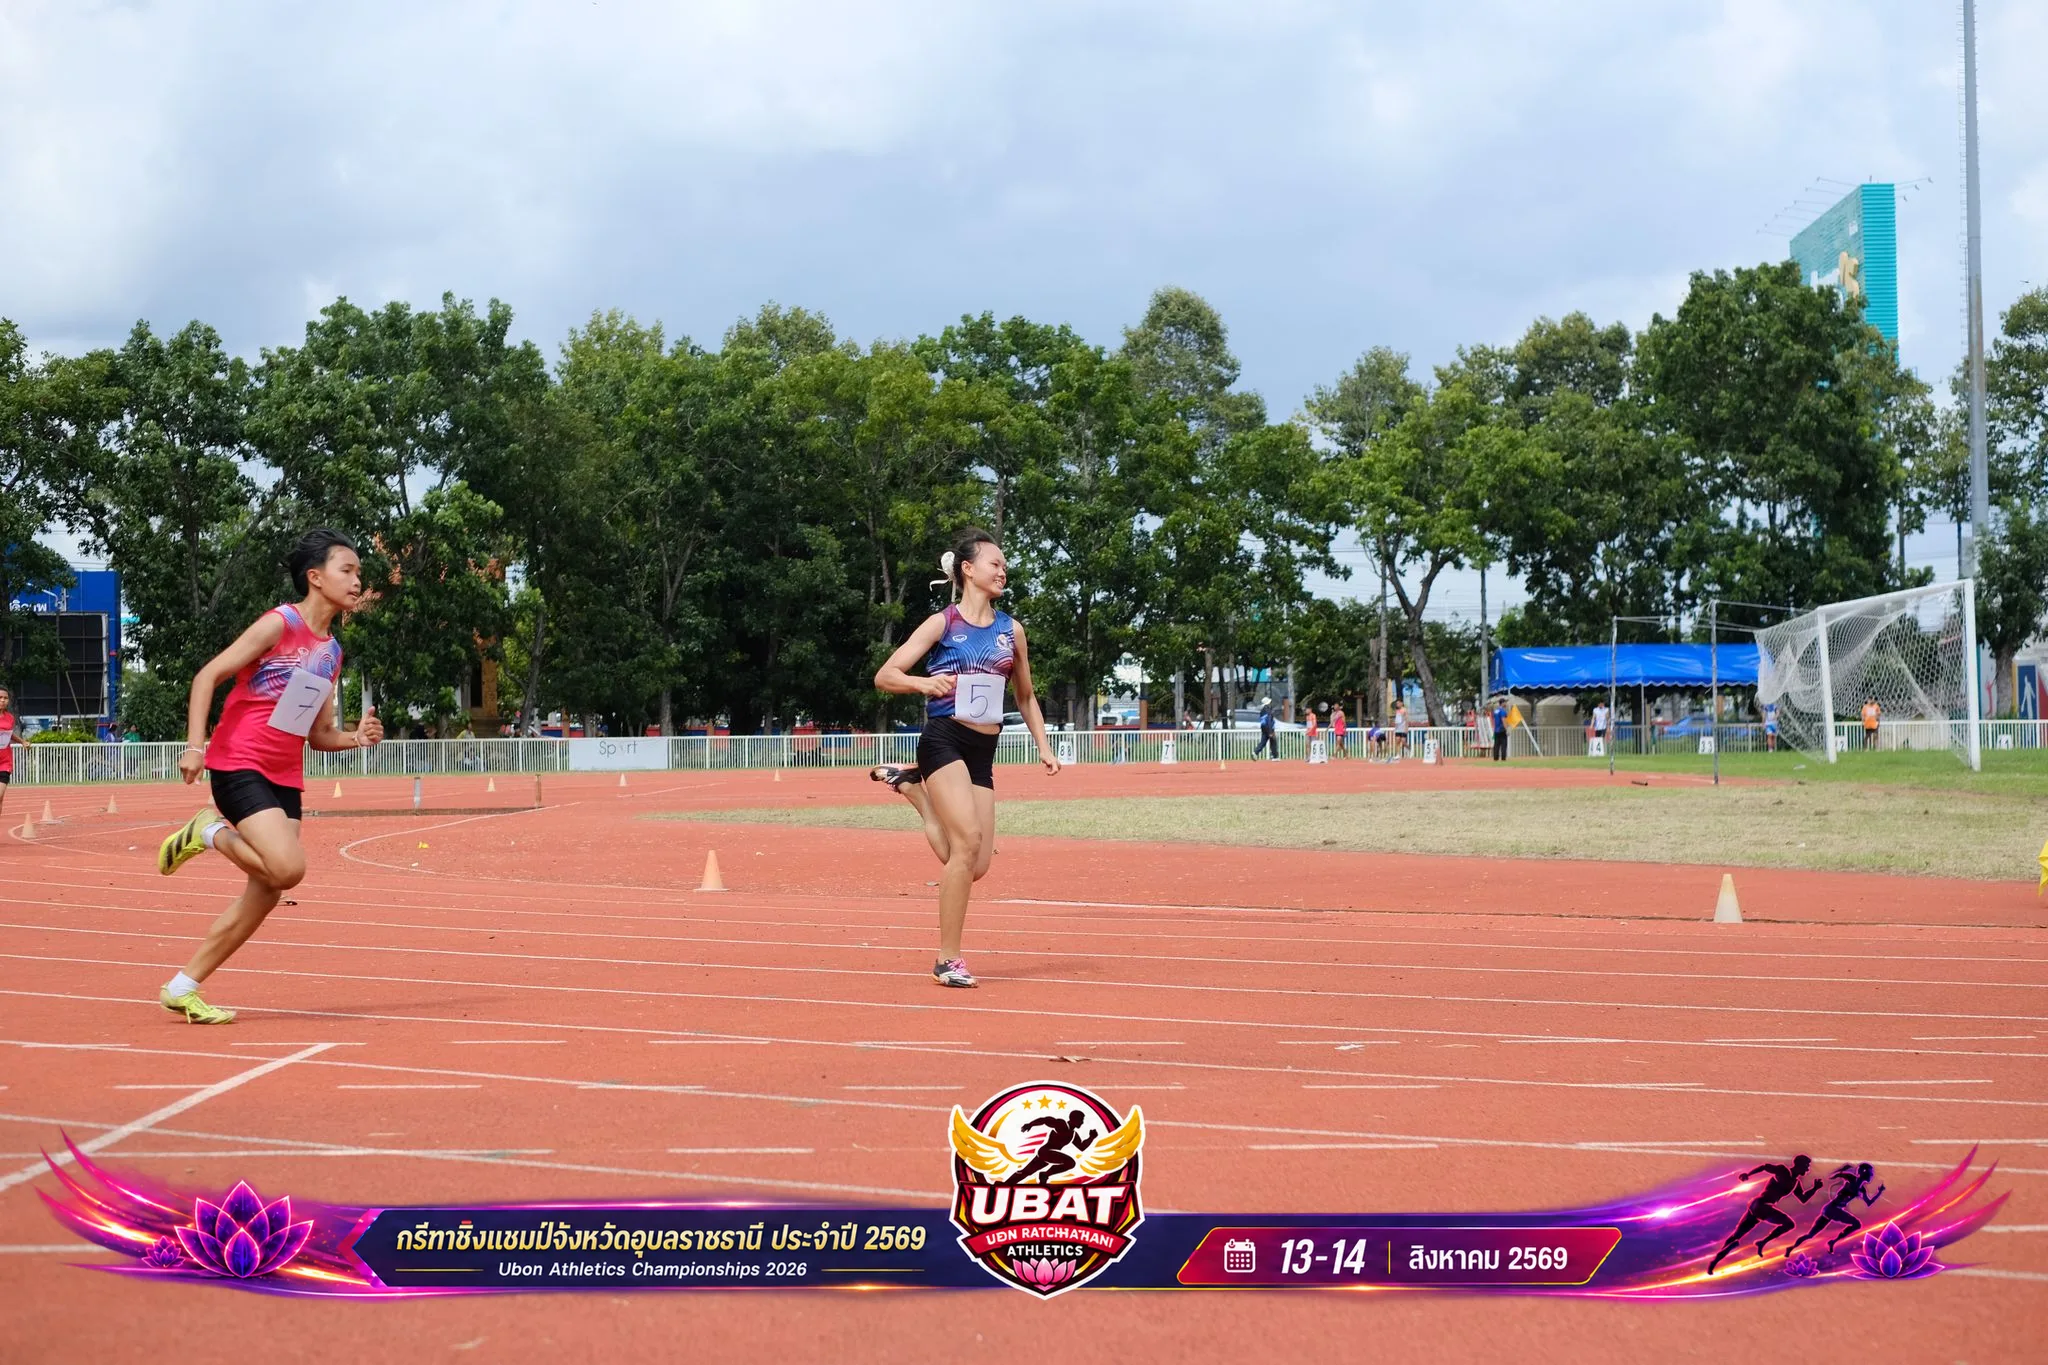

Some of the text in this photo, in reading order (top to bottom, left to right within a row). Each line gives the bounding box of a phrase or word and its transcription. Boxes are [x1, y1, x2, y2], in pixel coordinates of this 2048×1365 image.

[294, 685, 321, 722] 7
[968, 684, 992, 719] 5
[599, 740, 638, 758] Sprt
